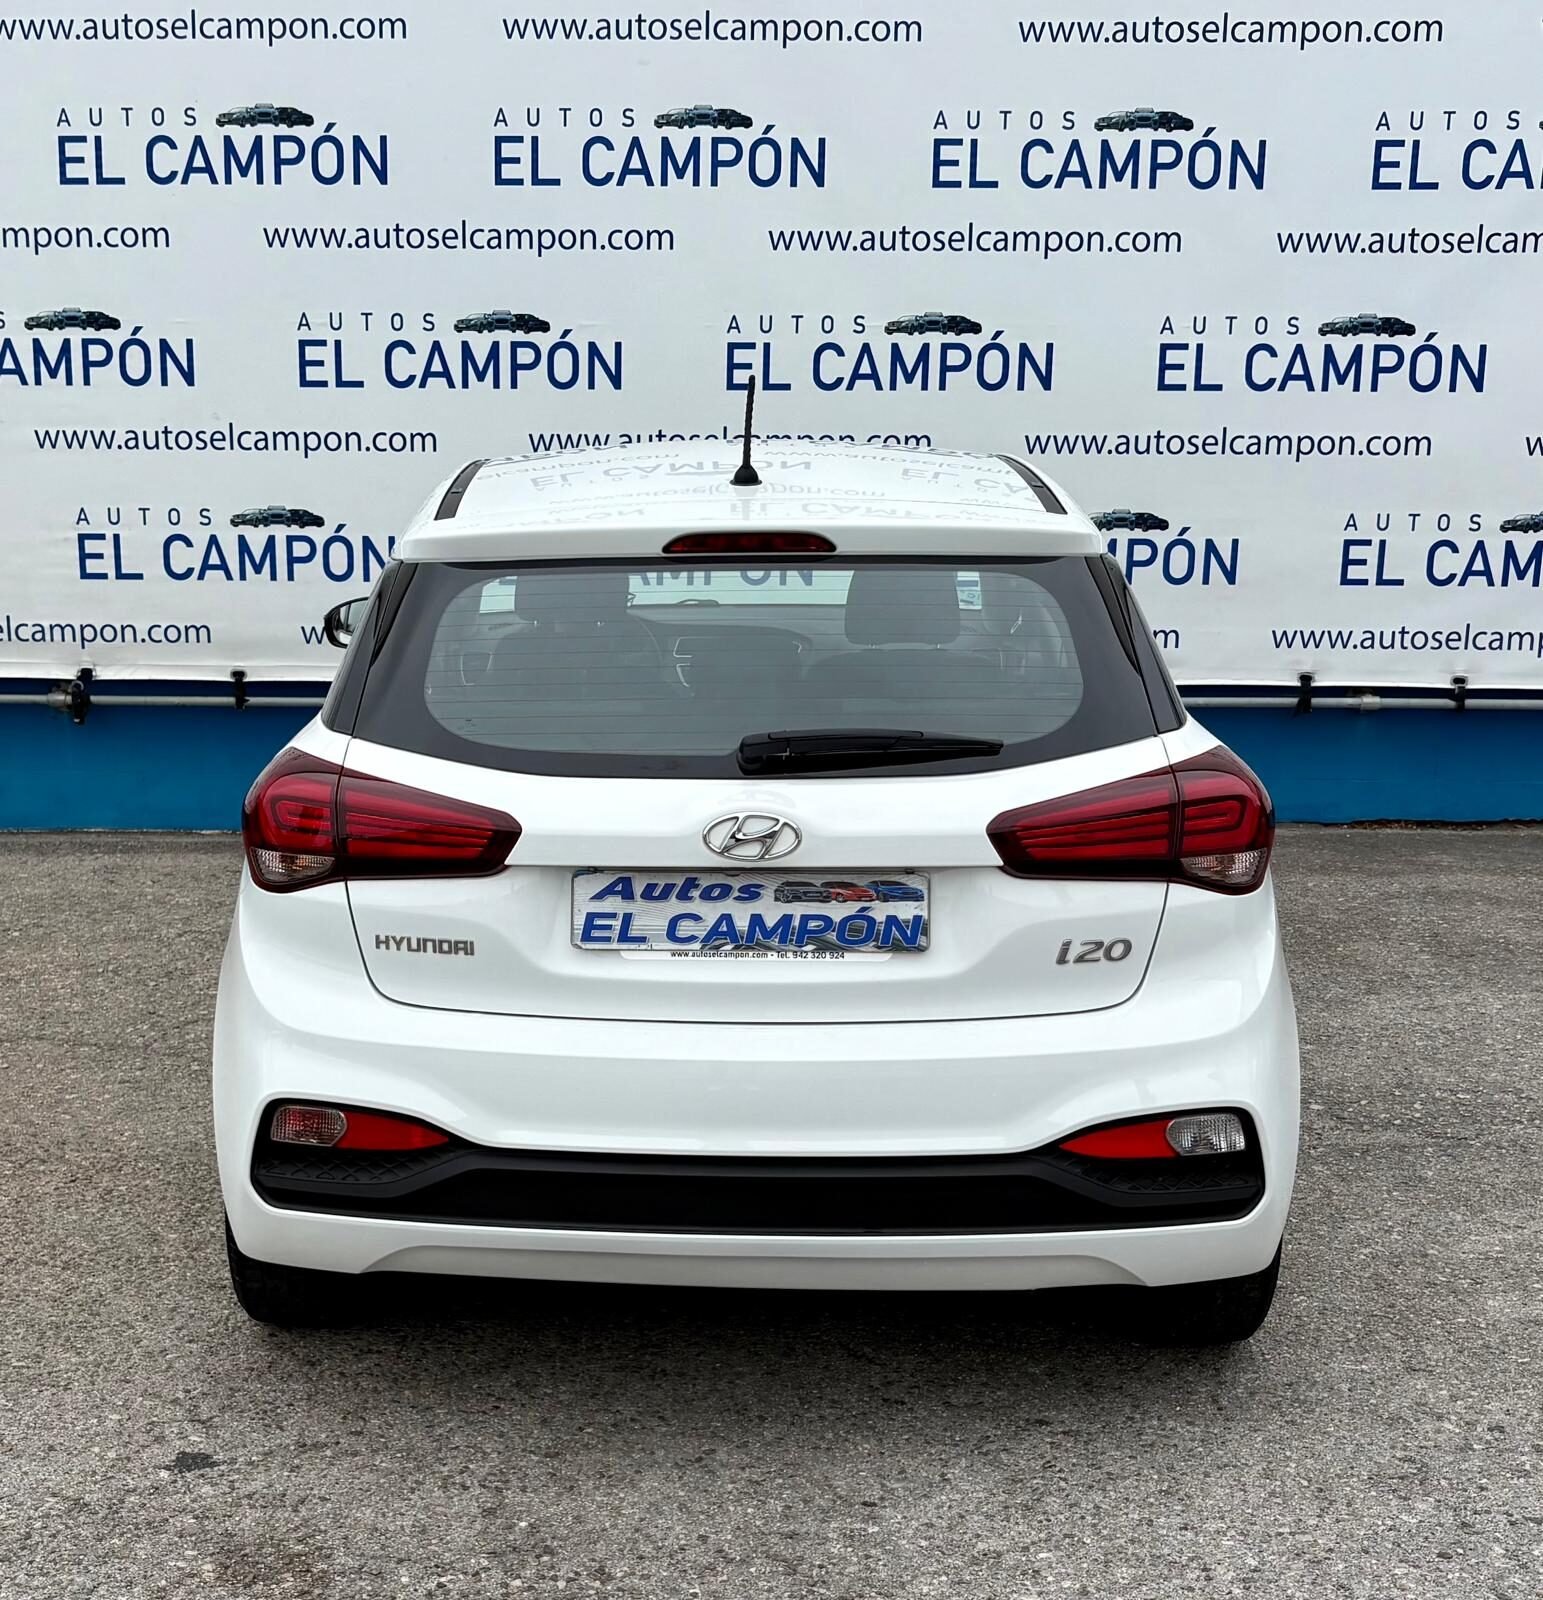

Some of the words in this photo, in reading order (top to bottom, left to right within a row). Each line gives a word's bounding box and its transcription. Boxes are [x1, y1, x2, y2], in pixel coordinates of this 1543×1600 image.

[503, 10, 921, 48] www.autoselcampon.com
[1019, 12, 1442, 50] www.autoselcampon.com
[57, 107, 196, 127] AUTOS
[494, 108, 634, 127] AUTOS
[933, 110, 1074, 130] AUTOS
[1376, 111, 1520, 131] AUTOS
[58, 136, 125, 185] EL
[146, 124, 387, 185] CAMPÓN
[495, 136, 560, 186] EL
[582, 125, 825, 187] CAMPÓN
[932, 138, 998, 188] EL
[1021, 127, 1266, 190] CAMPÓN
[1372, 140, 1439, 190] EL
[1462, 139, 1543, 190] CA
[263, 220, 673, 257] www.autoselcampon.com
[768, 222, 1181, 259] www.autoselcampon.com
[297, 312, 435, 331] AUTOS
[727, 315, 865, 334] AUTOS
[1160, 316, 1299, 335] AUTOS
[298, 339, 364, 388] EL
[385, 328, 622, 390] CAMPÓN
[726, 341, 792, 391] EL
[813, 329, 1053, 391] CAMPÓN
[1157, 343, 1223, 391] EL
[1245, 331, 1487, 392] CAMPÓN
[34, 422, 436, 458] www.autoselcampon.com
[1025, 427, 1431, 462] www.autoselcampon.com
[76, 507, 211, 526] AUTOS
[1344, 513, 1481, 532] AUTOS
[78, 533, 144, 580] EL
[1107, 526, 1240, 586] PÓN
[1340, 539, 1404, 586] EL
[0, 615, 211, 649] lcampon.com
[588, 876, 765, 903] Autos
[580, 912, 648, 944] EL
[665, 906, 924, 946] CAMPÓN
[374, 934, 475, 956] HYUNDAI
[1055, 938, 1133, 965] i20
